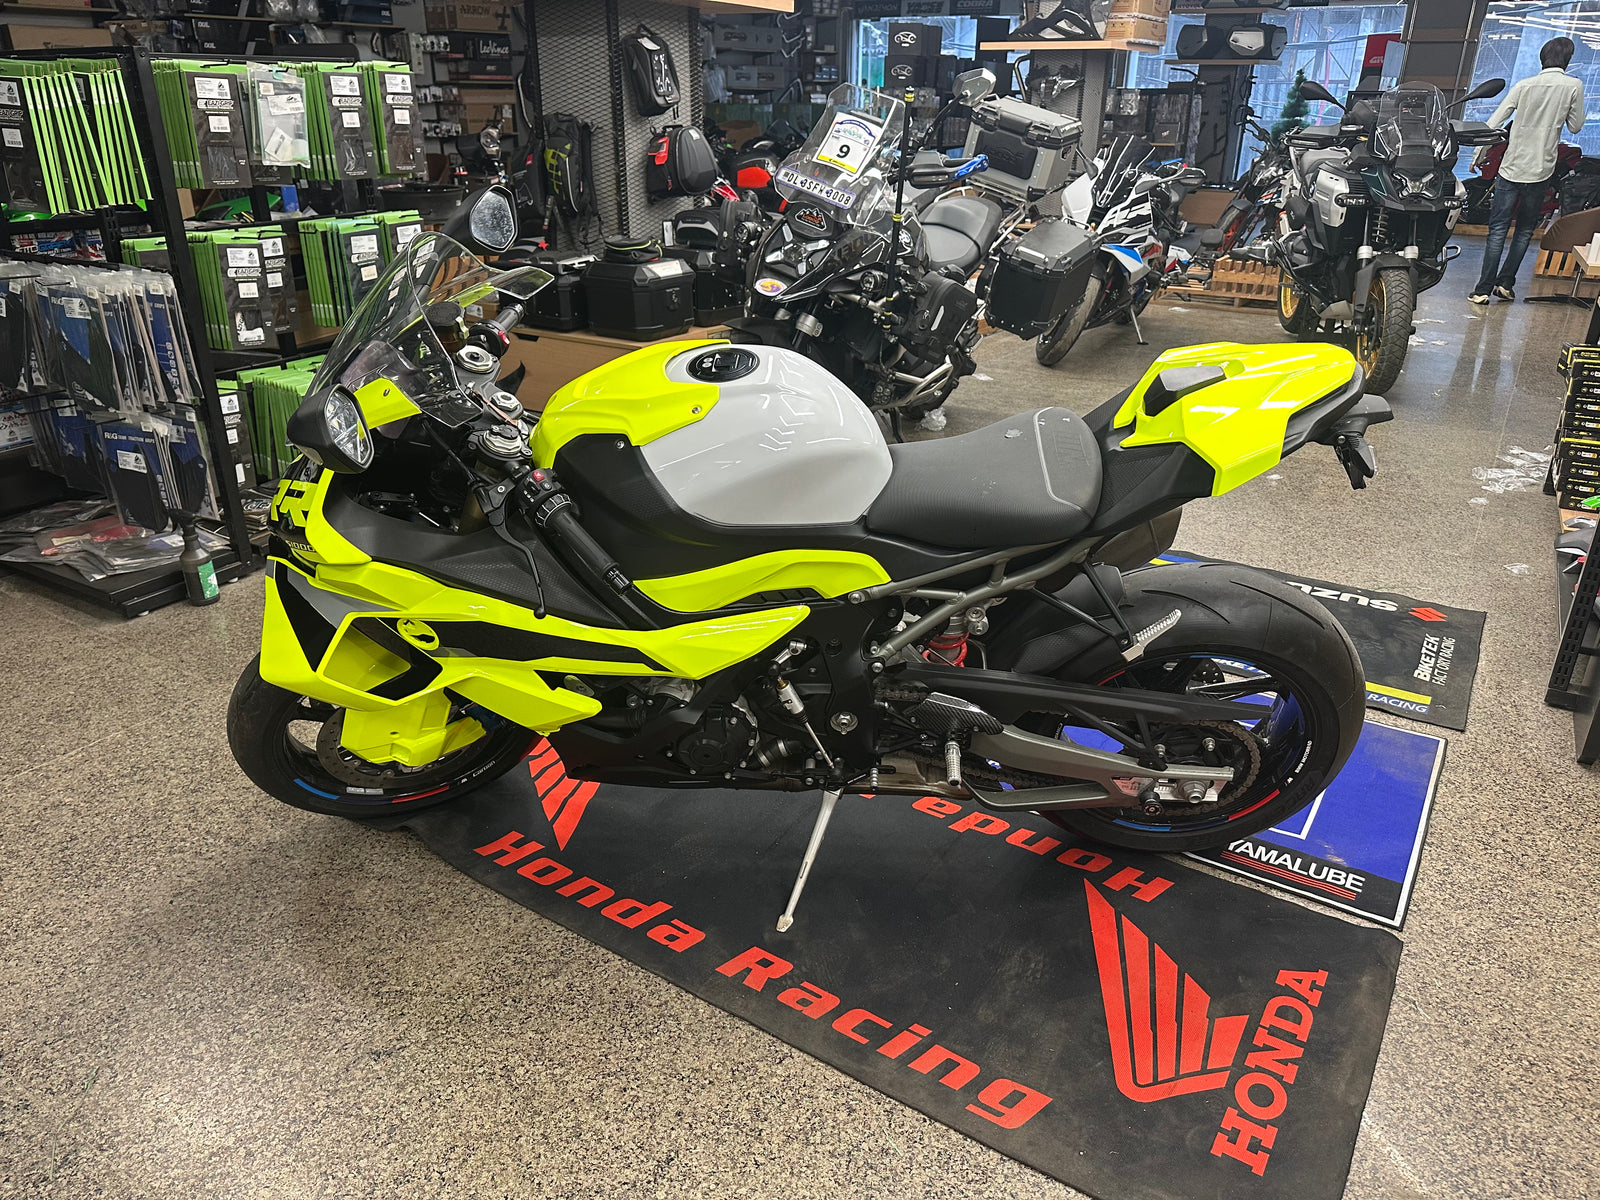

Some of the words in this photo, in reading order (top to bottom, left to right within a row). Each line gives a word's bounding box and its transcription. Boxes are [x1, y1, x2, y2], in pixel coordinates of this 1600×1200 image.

[957, 0, 993, 8] COBRA
[836, 144, 850, 158] 9
[787, 173, 799, 185] DL
[1413, 633, 1440, 682] BIKETEK
[1439, 636, 1456, 659] RACING
[1367, 693, 1428, 713] RACING
[912, 796, 1175, 903] Honda
[1228, 839, 1366, 893] YAMALUBE
[473, 831, 706, 953] Honda
[715, 946, 1053, 1129] Racing
[1210, 969, 1329, 1177] HONDA
